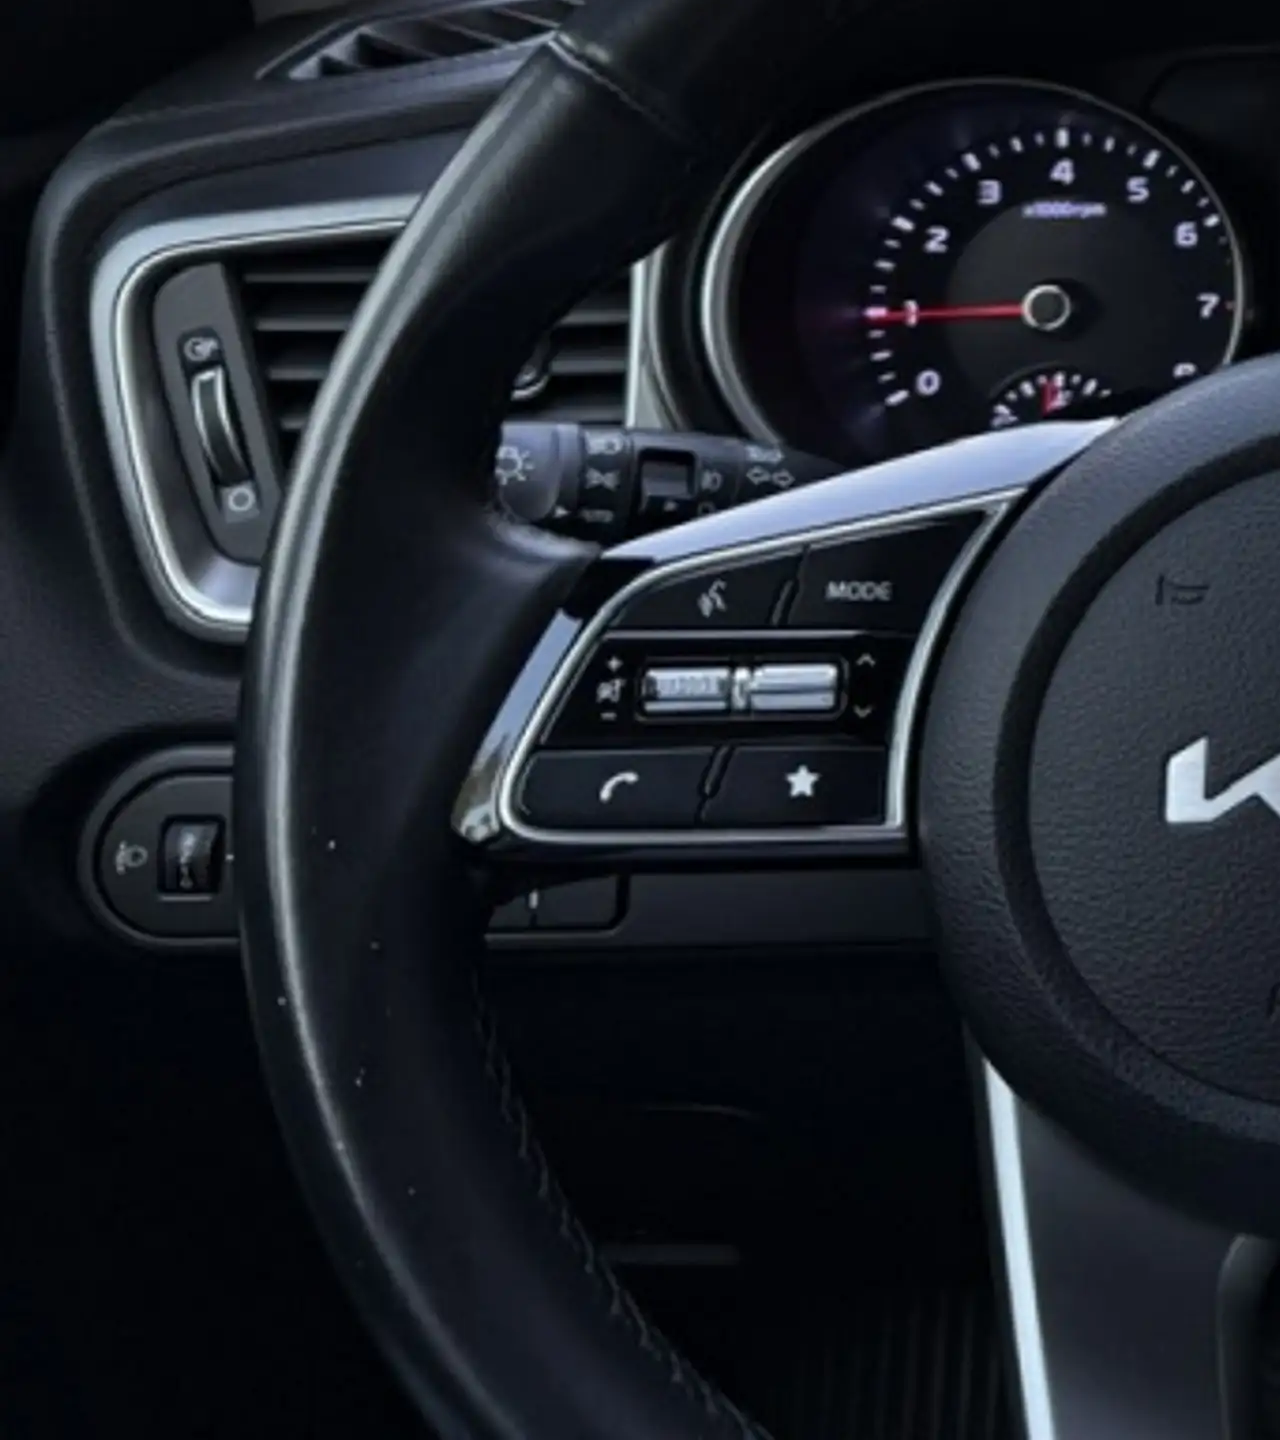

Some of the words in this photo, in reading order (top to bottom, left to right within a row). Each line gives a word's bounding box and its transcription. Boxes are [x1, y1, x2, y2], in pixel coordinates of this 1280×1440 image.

[1050, 158, 1075, 185] 4
[977, 179, 1002, 205] 3
[1126, 176, 1150, 203] 5
[924, 226, 950, 253] 2
[1174, 221, 1200, 248] 6
[1197, 292, 1221, 318] 7
[916, 369, 941, 396] 0
[825, 581, 893, 601] MODE
